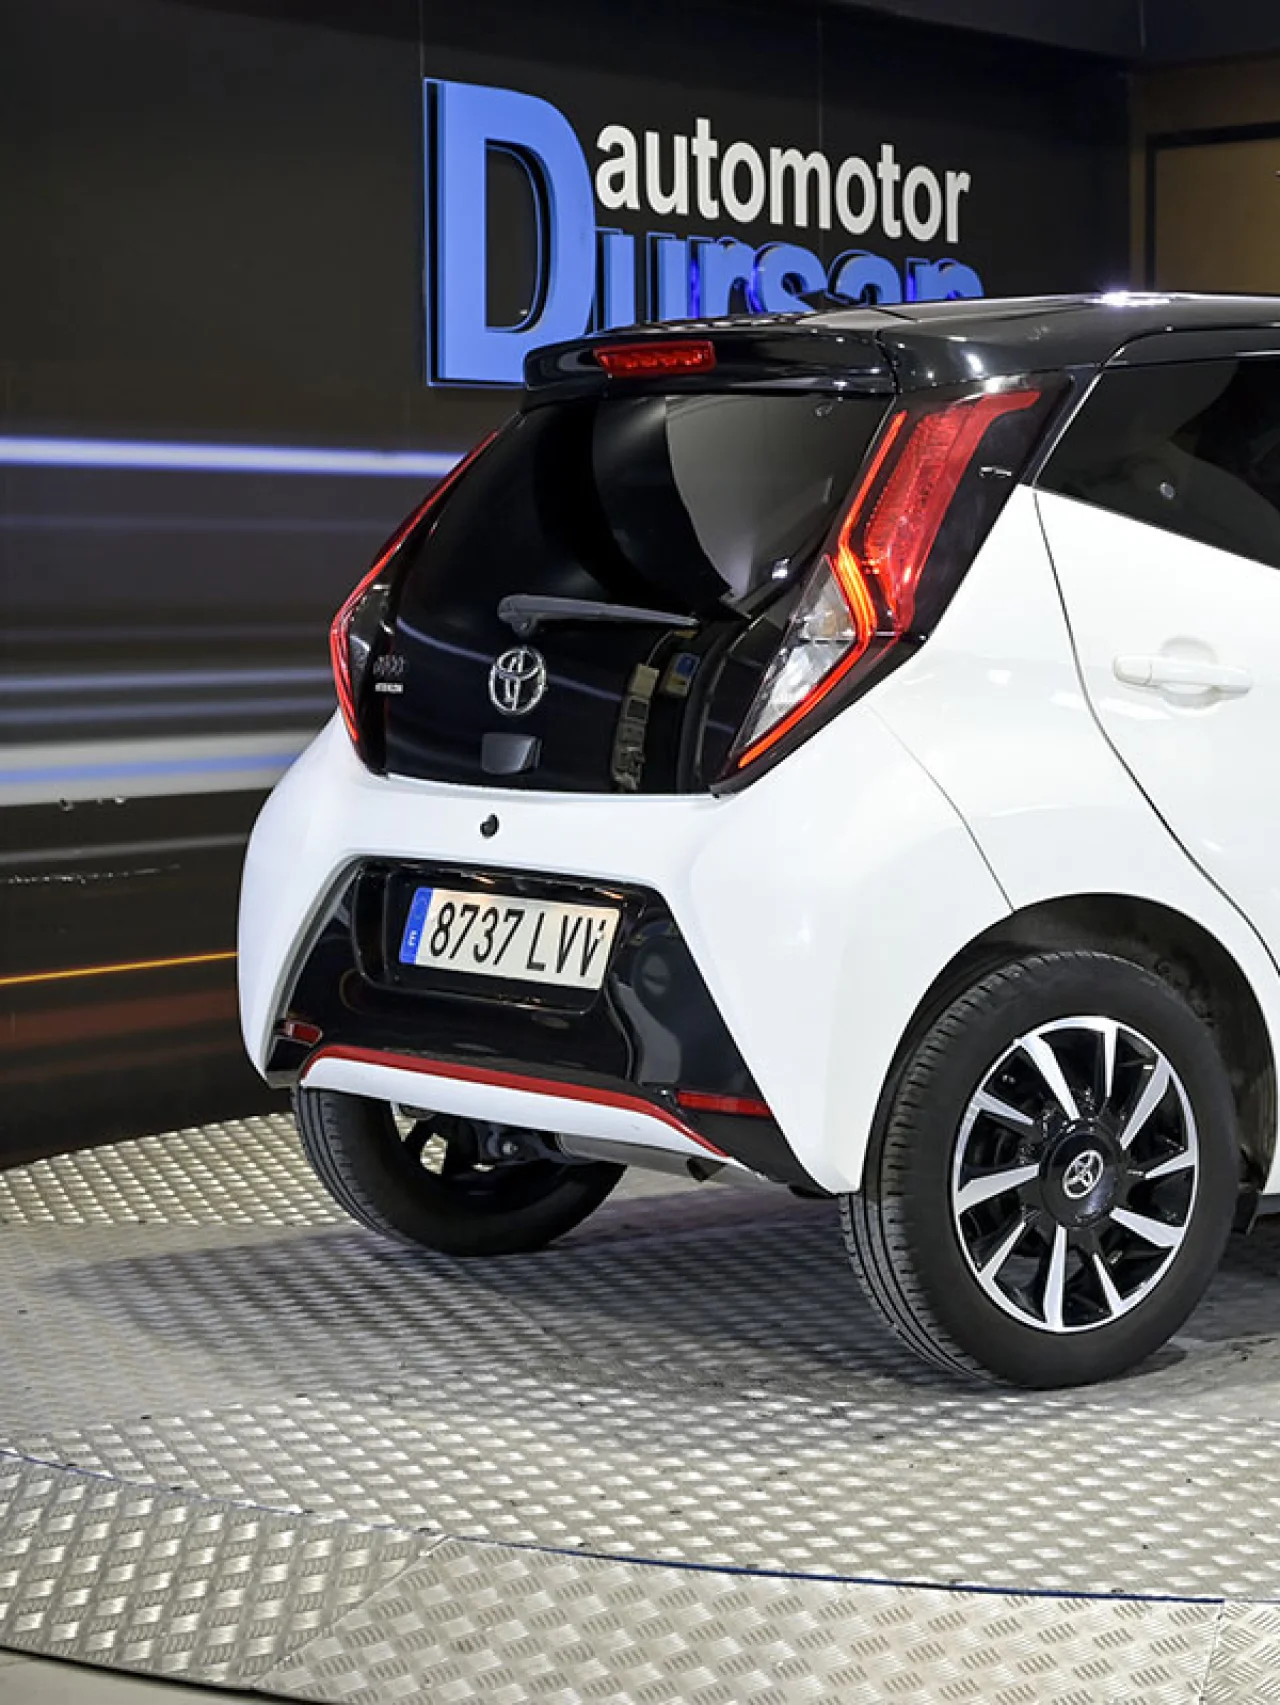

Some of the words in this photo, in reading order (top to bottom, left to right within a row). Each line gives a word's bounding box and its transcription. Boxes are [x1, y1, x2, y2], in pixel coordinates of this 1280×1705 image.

[596, 117, 972, 244] automotor
[408, 930, 417, 946] E
[429, 902, 525, 966] 8737
[526, 911, 607, 978] LVV
